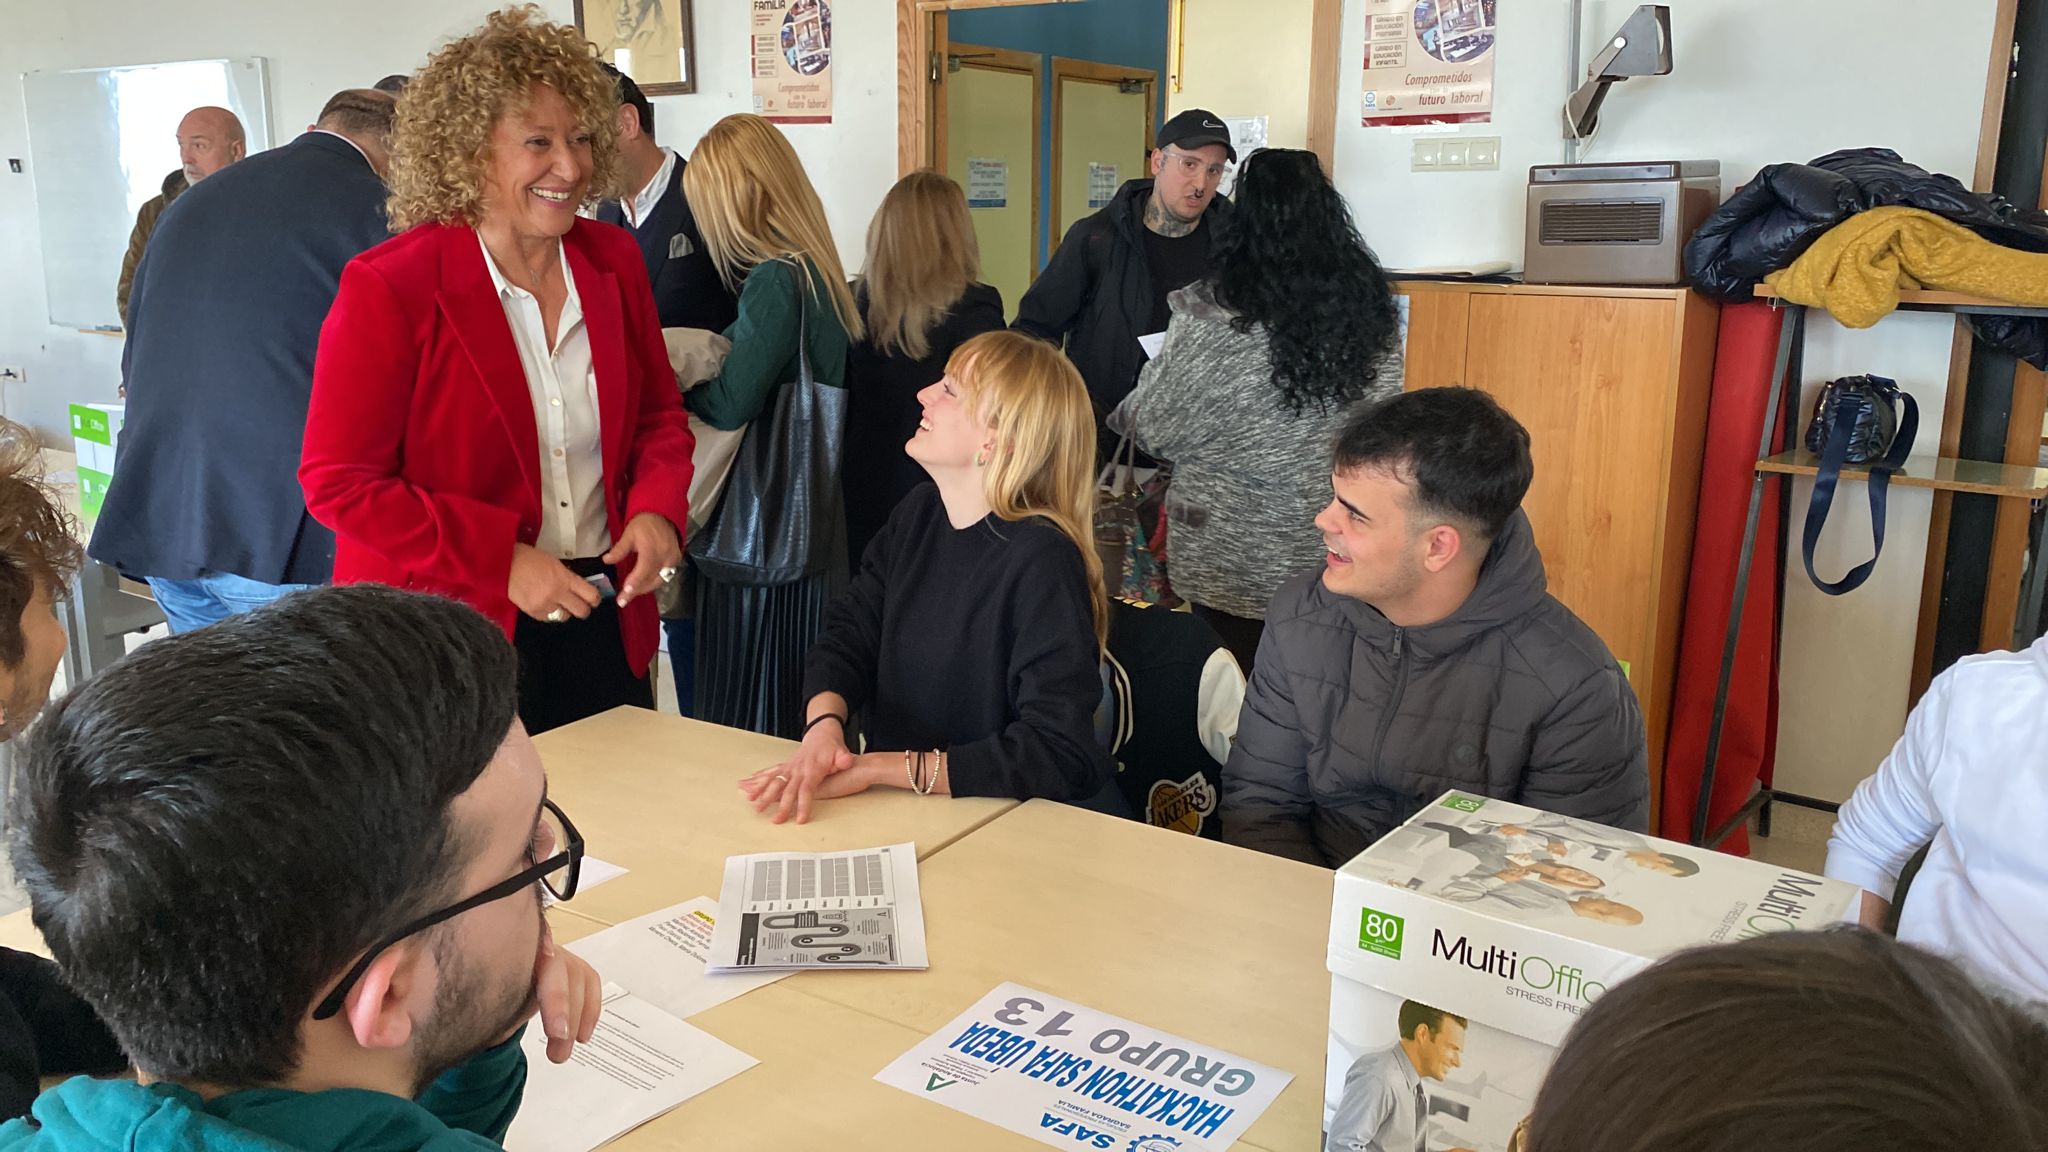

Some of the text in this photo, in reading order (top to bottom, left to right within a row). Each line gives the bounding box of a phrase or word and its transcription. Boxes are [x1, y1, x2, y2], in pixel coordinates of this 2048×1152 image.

[1405, 70, 1473, 88] Comprometidos
[1418, 90, 1484, 106] futuro laboral
[1365, 913, 1398, 943] 80
[1505, 986, 1553, 1007] STRESS
[994, 997, 1257, 1097] GRUPO 13
[1019, 1045, 1093, 1088] SAFA
[1058, 1099, 1090, 1114] FAMILIA
[1072, 1064, 1235, 1139] HACKATHON
[1040, 1112, 1116, 1149] SAFA
